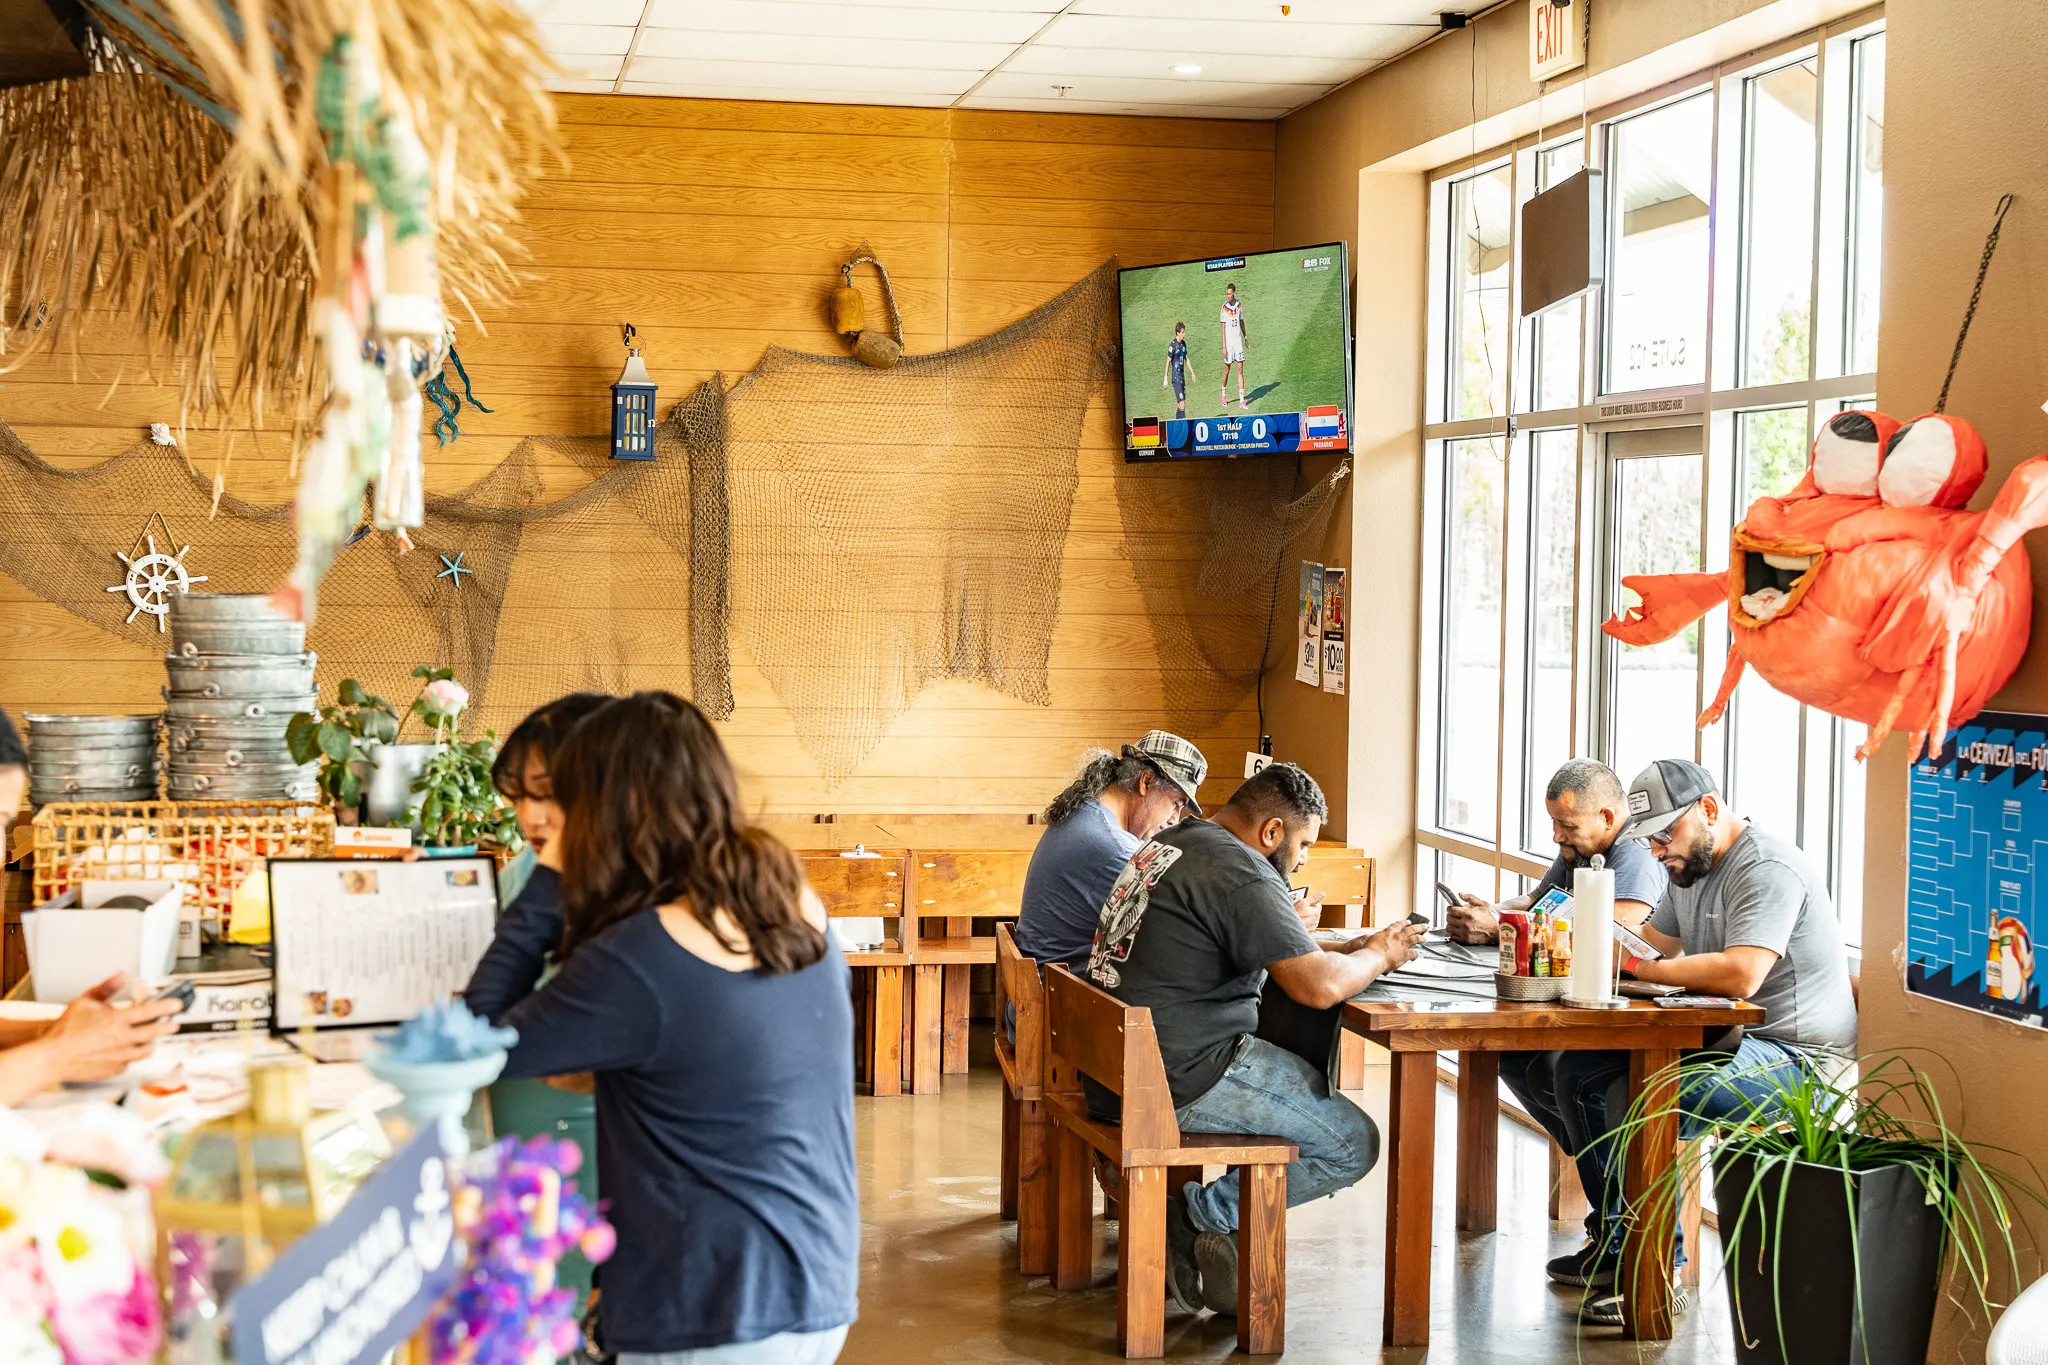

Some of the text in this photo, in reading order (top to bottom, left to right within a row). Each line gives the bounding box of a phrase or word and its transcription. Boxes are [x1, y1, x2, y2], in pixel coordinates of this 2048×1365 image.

[1319, 256, 1331, 266] FOX
[1195, 421, 1209, 443] 0
[1217, 422, 1243, 431] 1ST HALF
[1252, 418, 1267, 440] 0
[1958, 745, 1970, 759] LA
[1970, 741, 2016, 768] CERVEZA
[2015, 751, 2032, 766] DEL
[1253, 758, 1264, 774] 6
